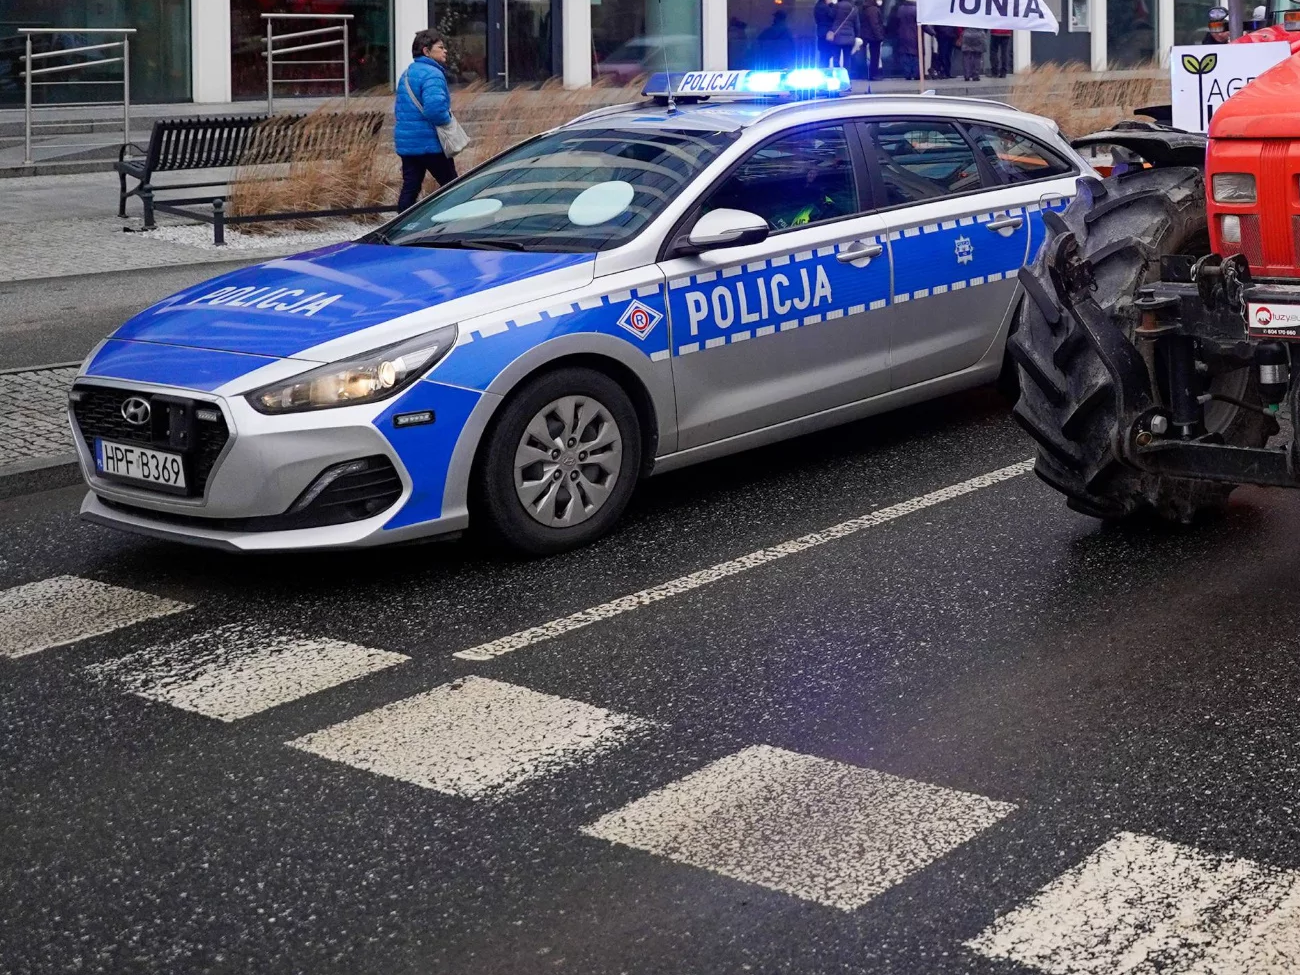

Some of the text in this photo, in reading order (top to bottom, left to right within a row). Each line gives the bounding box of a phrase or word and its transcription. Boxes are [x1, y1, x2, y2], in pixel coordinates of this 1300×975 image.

[681, 73, 739, 92] POLICJA
[186, 286, 344, 317] POLICJA
[685, 264, 832, 336] POLICJA
[104, 444, 134, 475] HPF
[140, 451, 180, 485] B369
